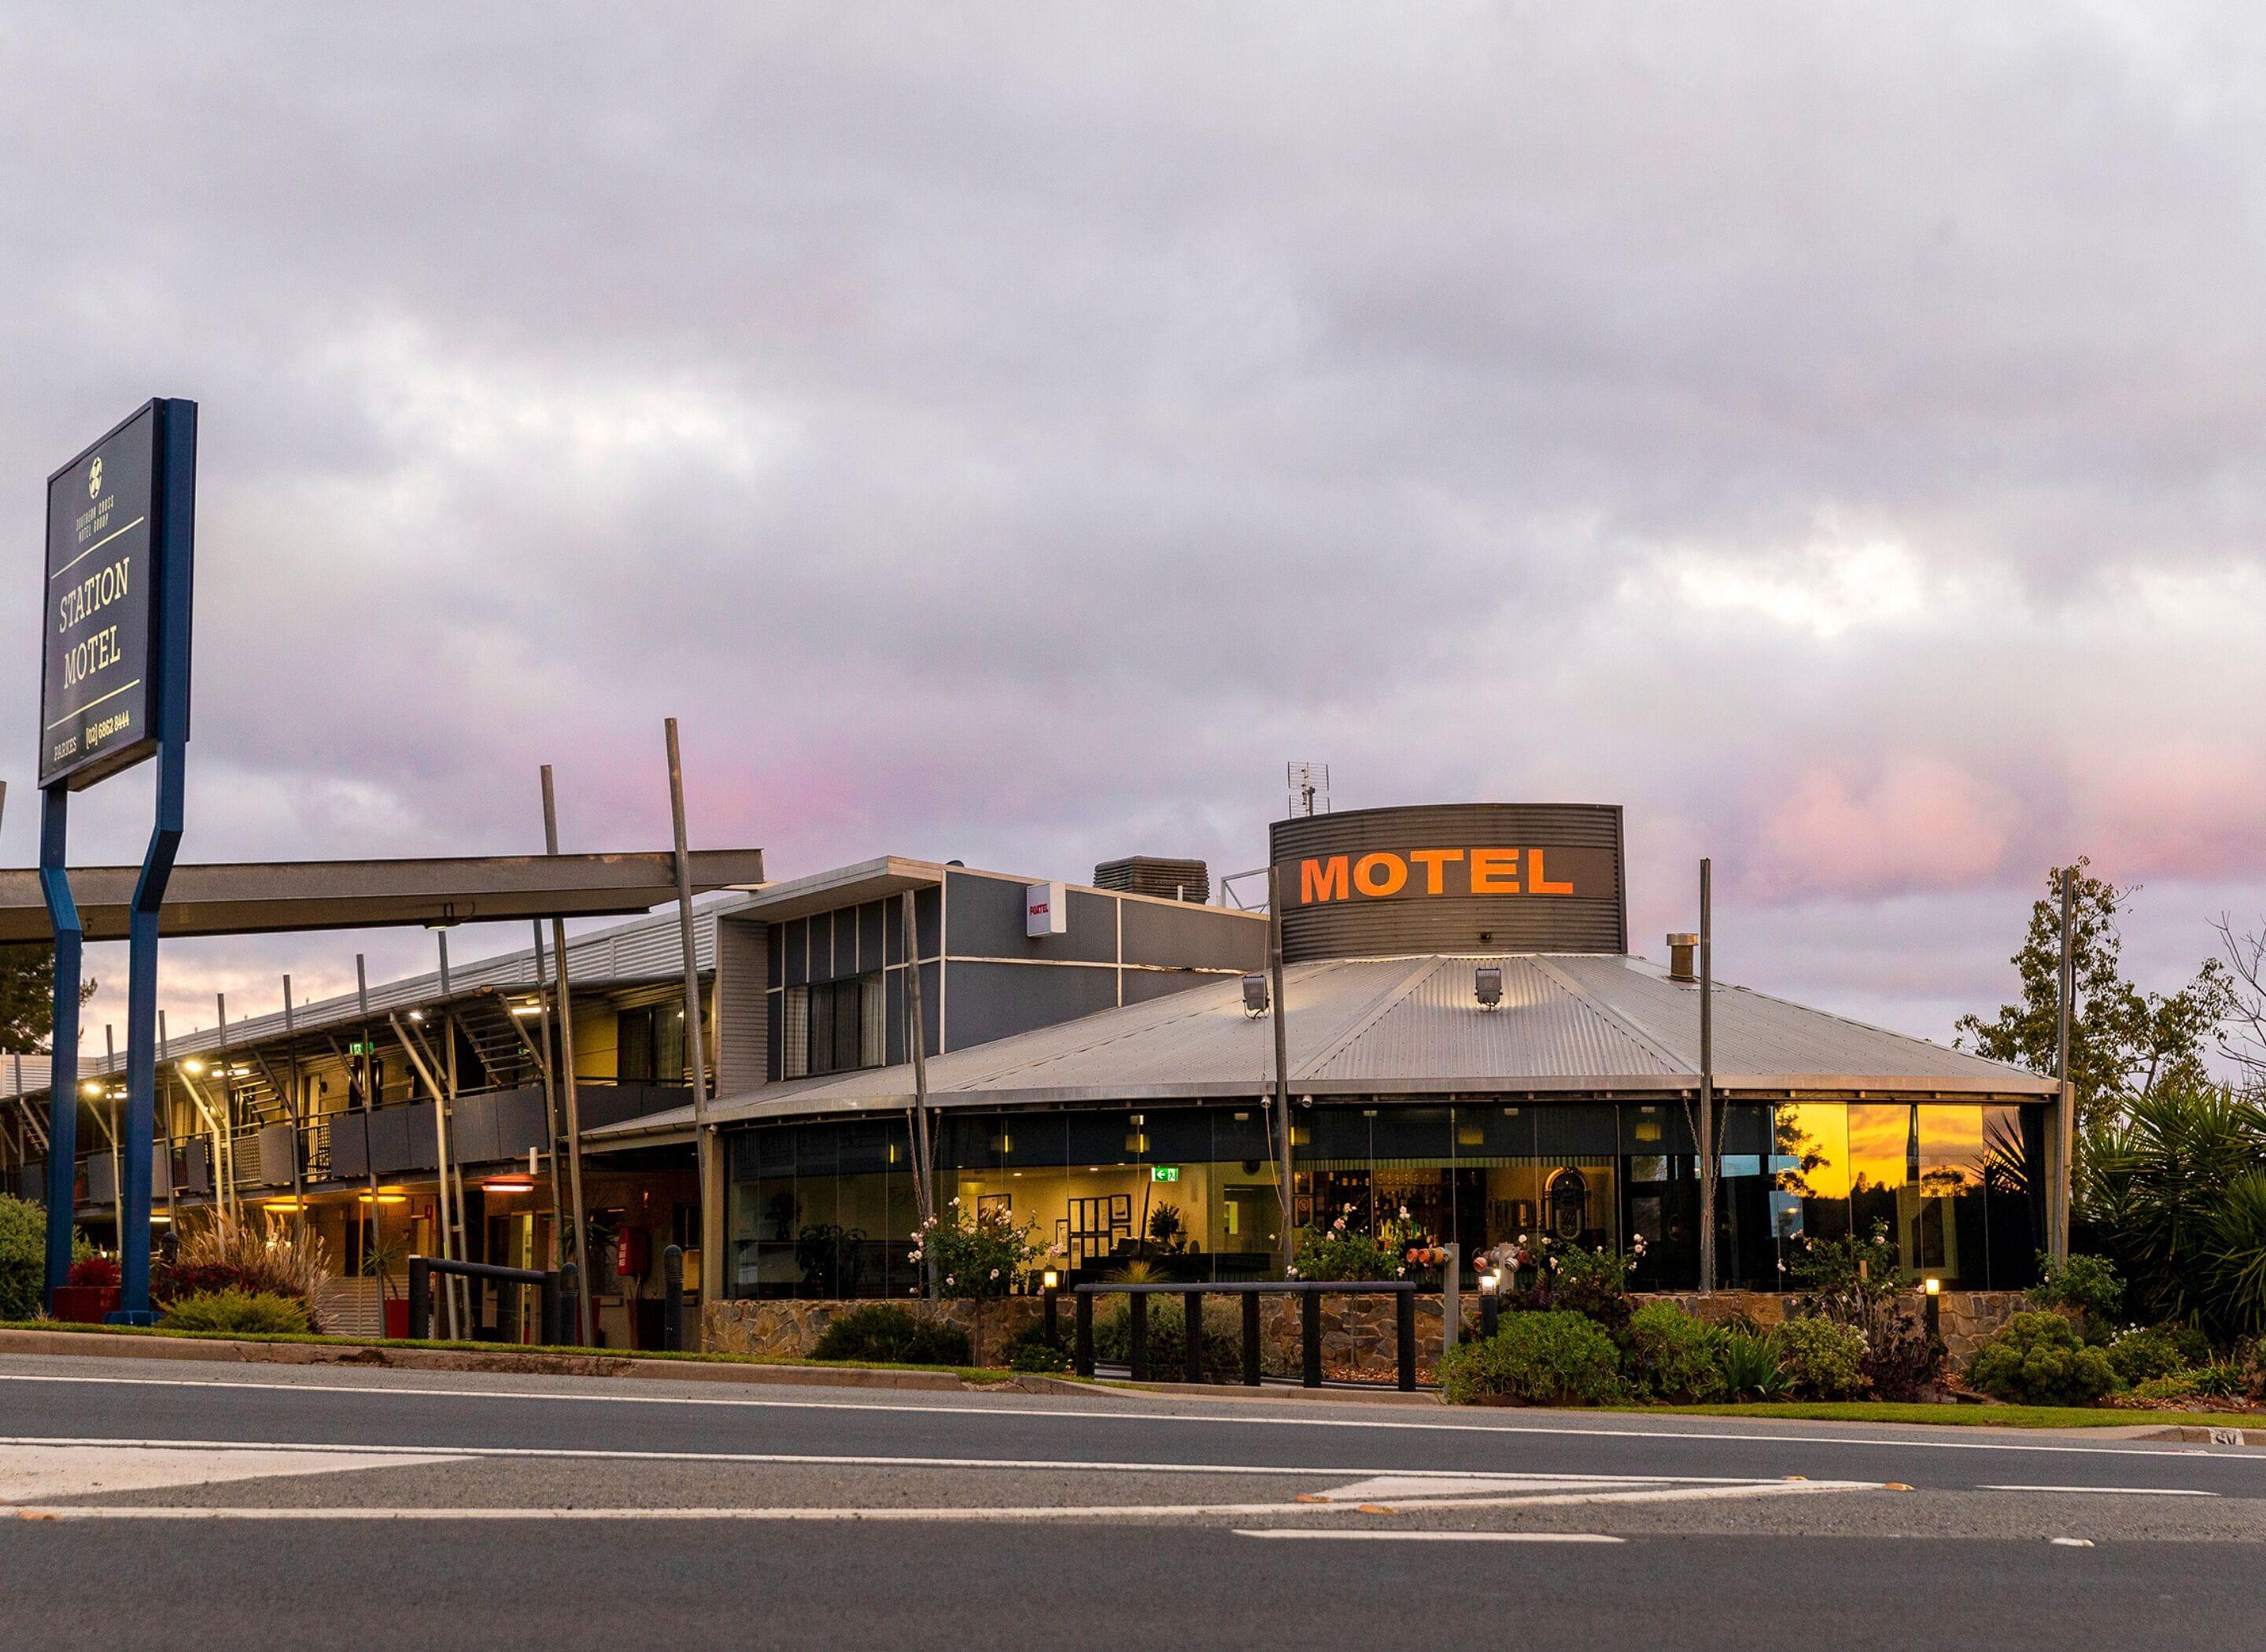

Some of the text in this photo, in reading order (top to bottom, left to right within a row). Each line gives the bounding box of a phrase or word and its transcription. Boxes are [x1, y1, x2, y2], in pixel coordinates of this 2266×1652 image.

[59, 556, 130, 633] STATION
[64, 625, 120, 690] MOTEL
[54, 736, 77, 761] PARKES
[114, 710, 130, 732] 8444
[1301, 848, 1574, 905] MOTEL
